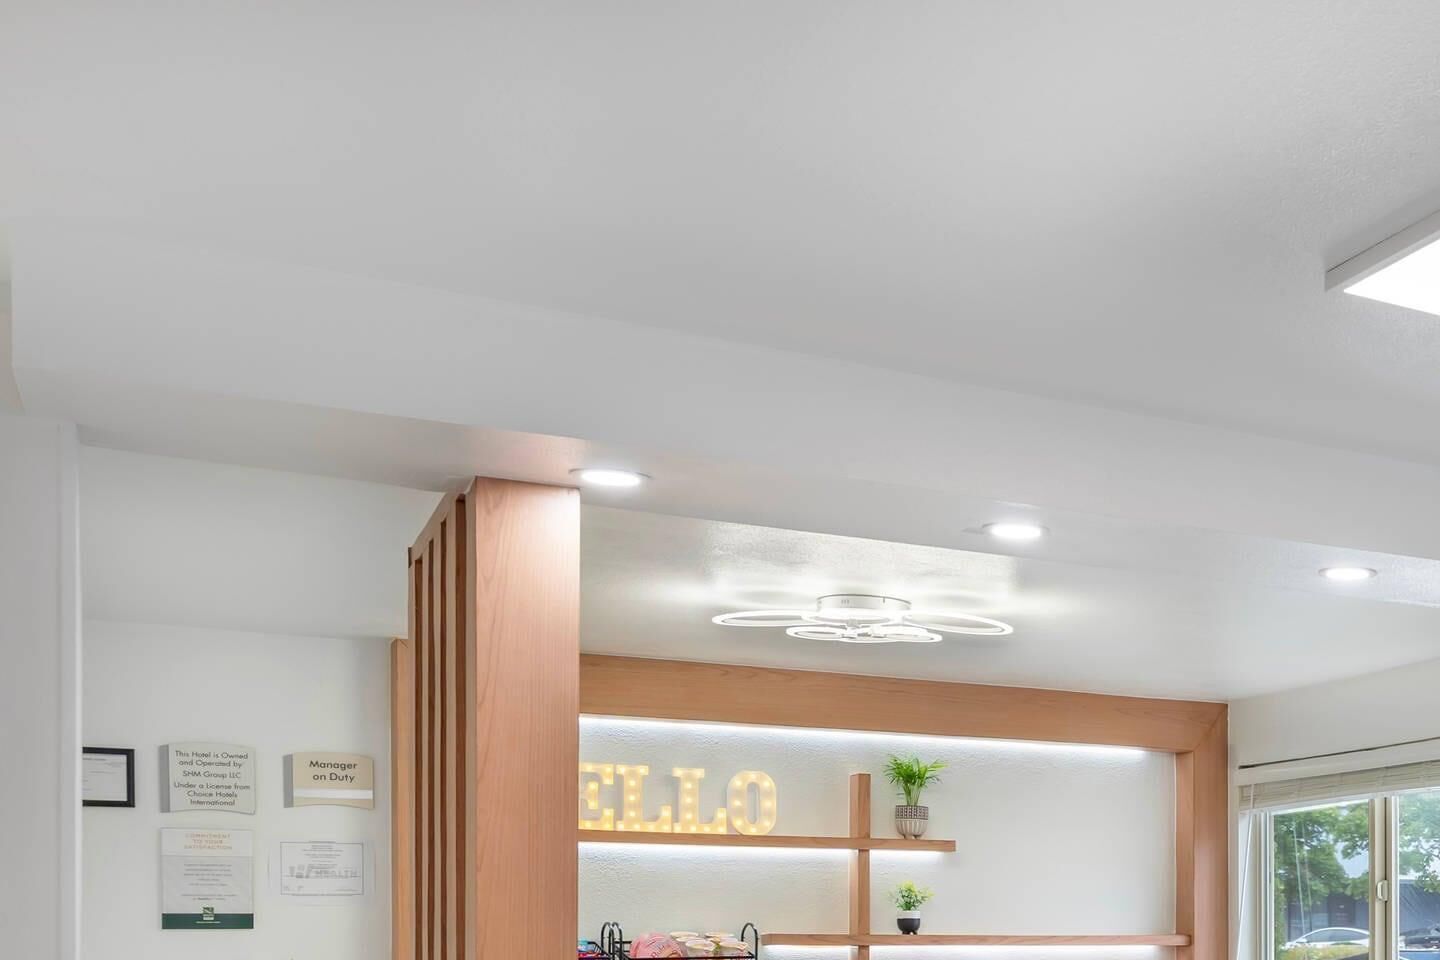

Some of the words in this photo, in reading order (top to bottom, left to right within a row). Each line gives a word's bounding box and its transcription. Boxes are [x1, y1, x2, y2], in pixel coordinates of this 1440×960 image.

[220, 752, 248, 760] Owned
[233, 760, 242, 768] by
[309, 760, 357, 771] Manager
[203, 771, 228, 779] Group
[329, 773, 355, 783] Duty
